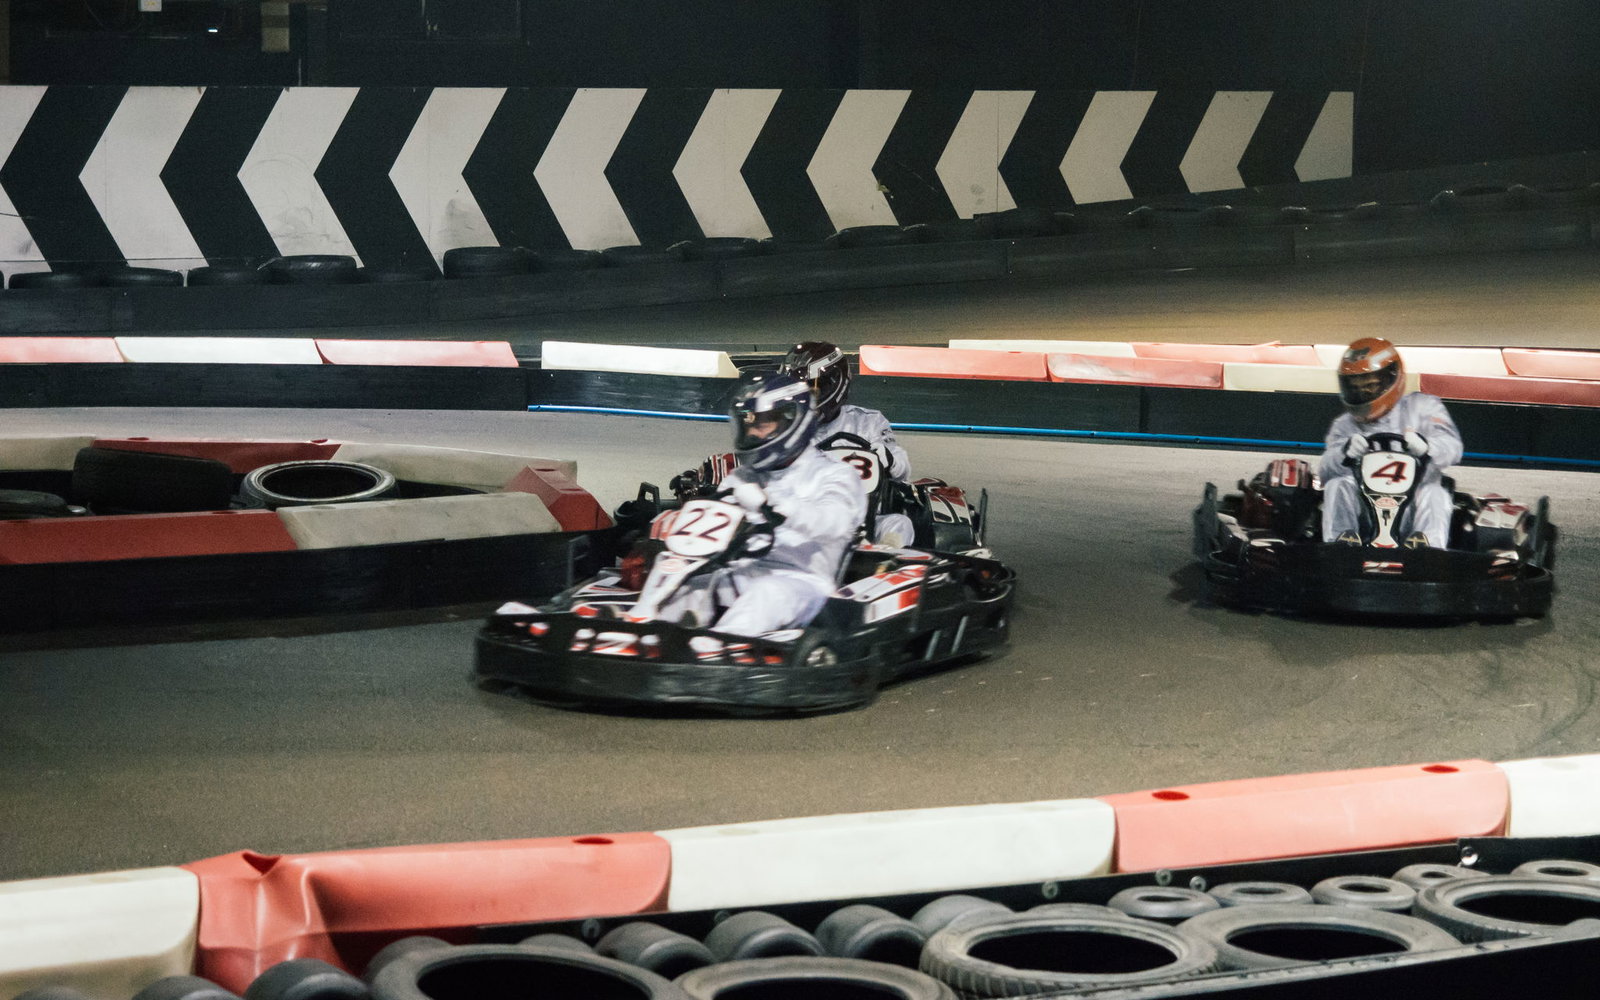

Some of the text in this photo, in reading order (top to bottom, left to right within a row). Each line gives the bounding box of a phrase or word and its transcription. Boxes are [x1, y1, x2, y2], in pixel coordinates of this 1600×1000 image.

[841, 454, 873, 480] 3
[1370, 461, 1407, 483] 4
[672, 507, 731, 543] 22
